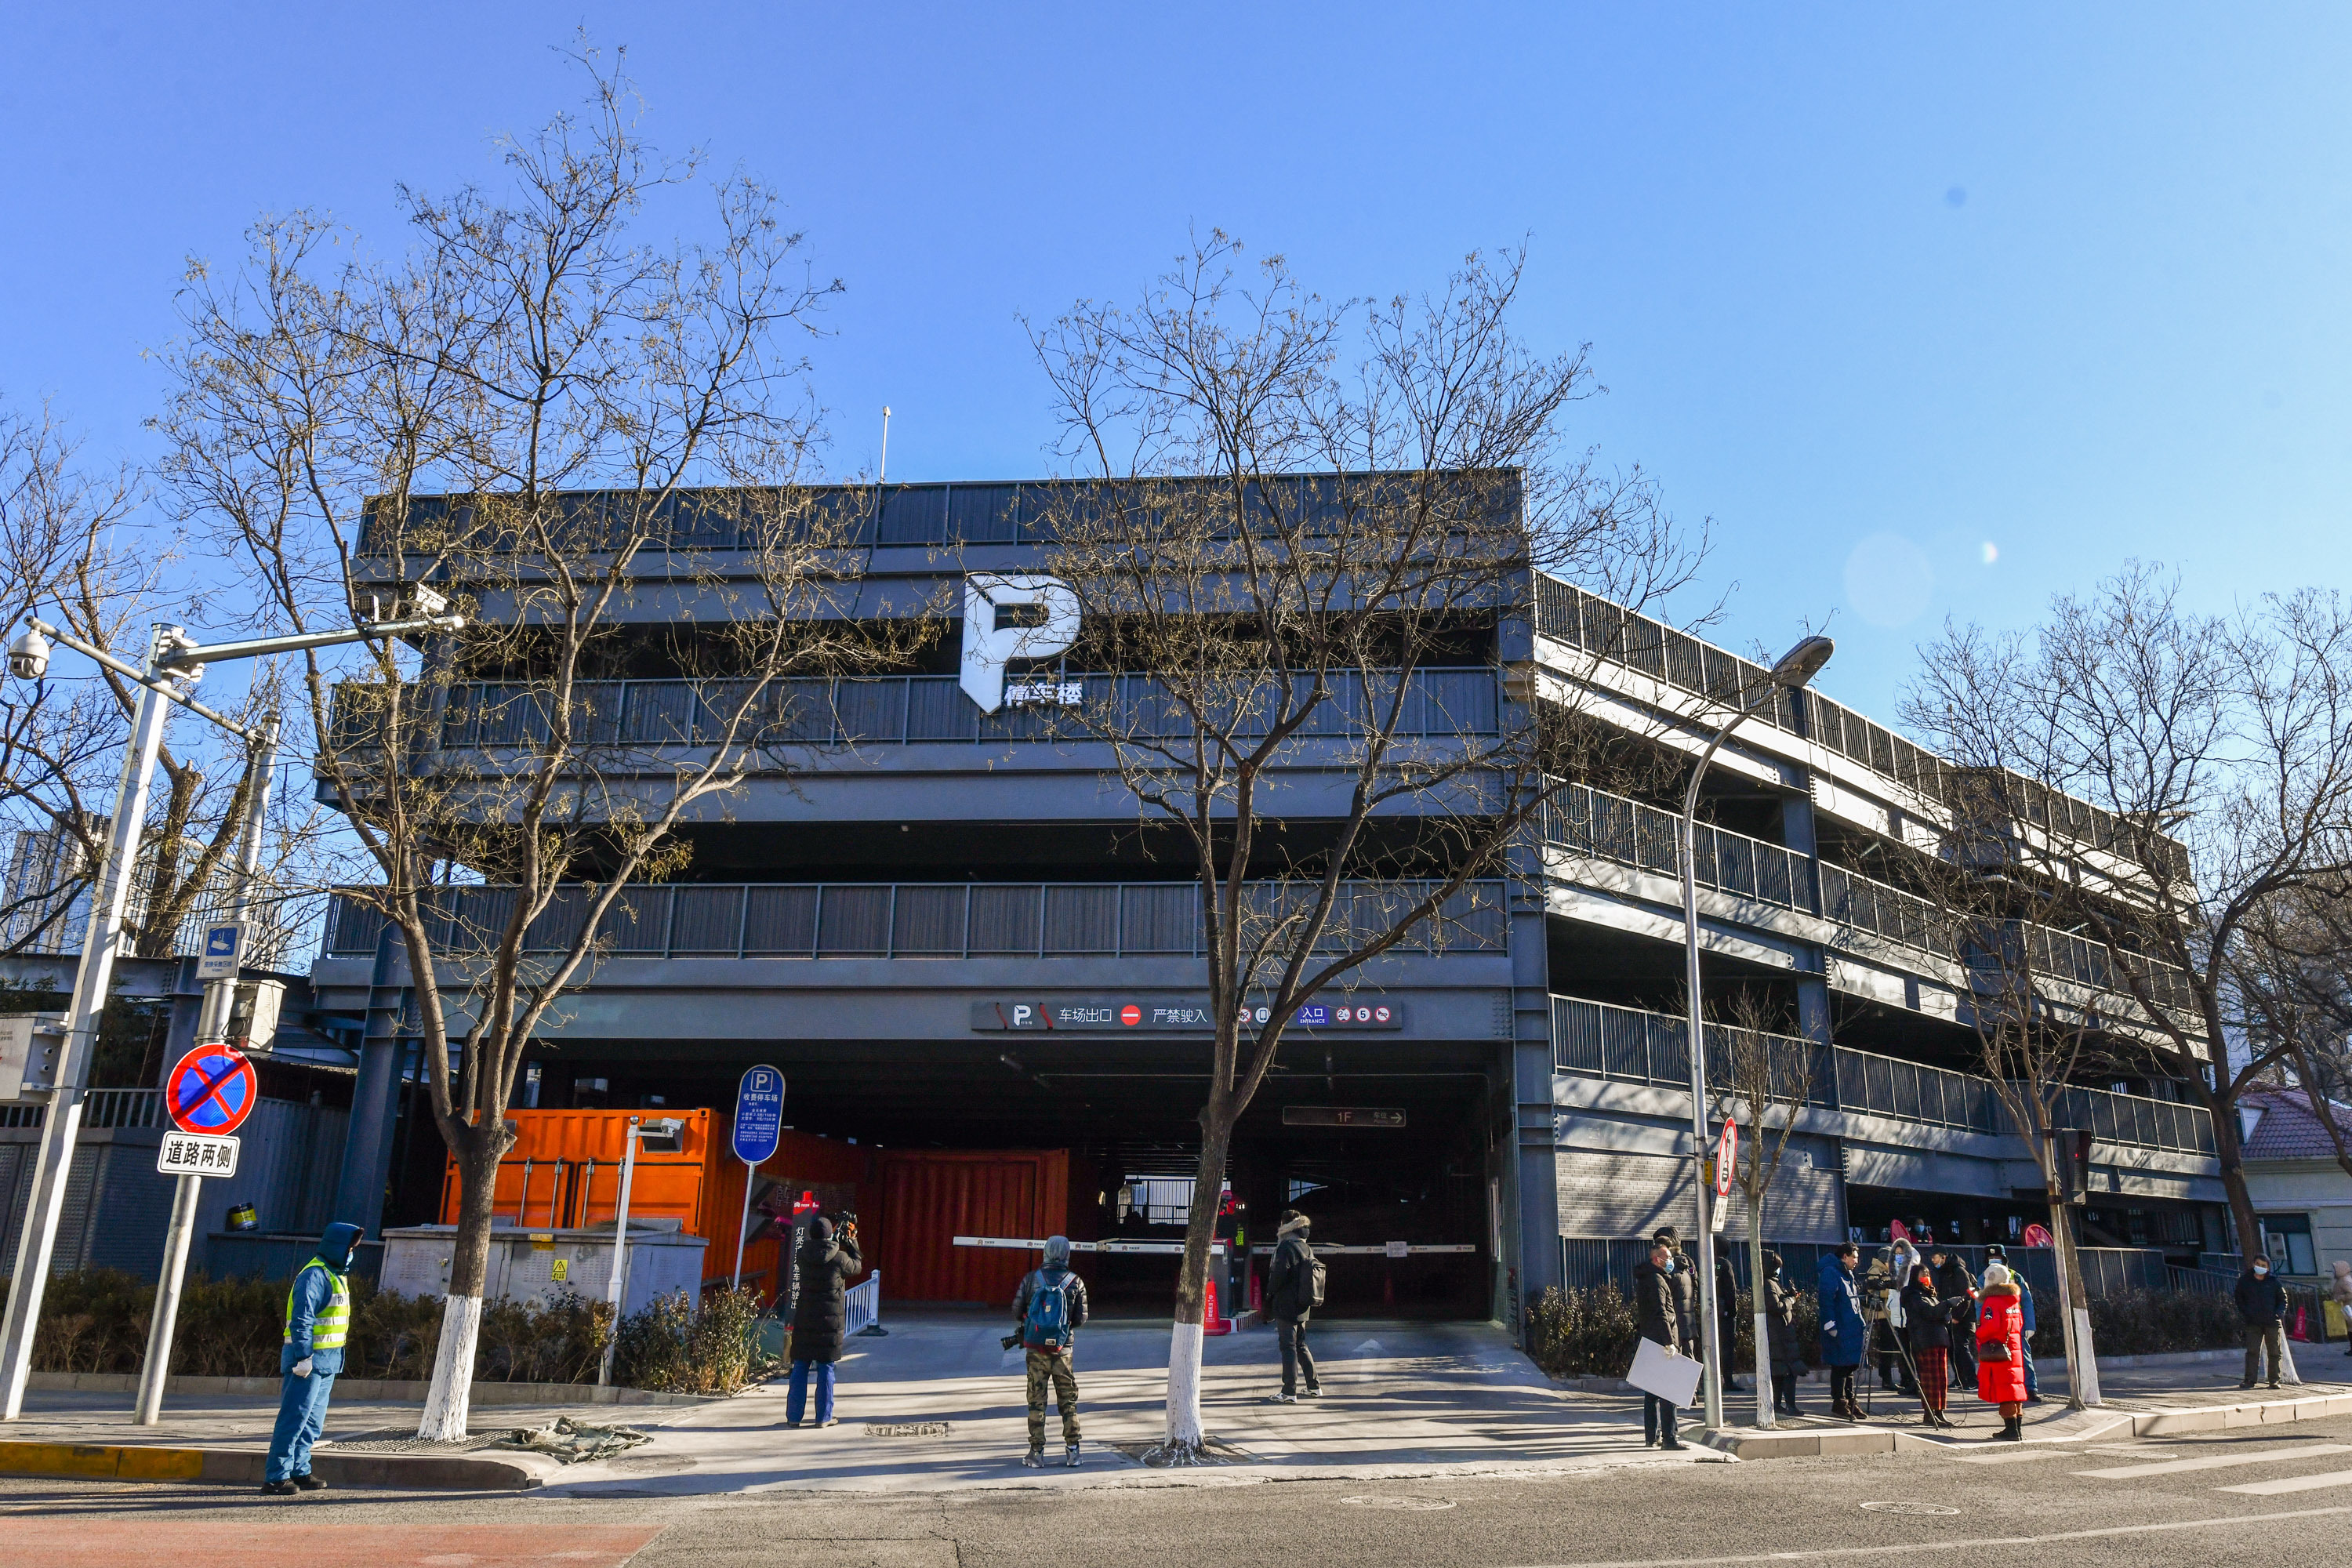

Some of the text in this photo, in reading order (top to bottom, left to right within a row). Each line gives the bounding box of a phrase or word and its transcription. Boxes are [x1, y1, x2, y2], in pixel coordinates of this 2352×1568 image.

[960, 575, 1082, 714] P
[1004, 682, 1083, 706] 停车楼
[1058, 1007, 1207, 1024] 车场出口 严禁驶入
[1302, 1007, 1324, 1018] 入口
[1360, 1010, 1367, 1018] 5
[756, 1073, 768, 1089] P
[742, 1093, 779, 1102] 收费停车场
[1337, 1112, 1352, 1123] 1F
[165, 1140, 233, 1169] 道路两侧
[790, 1226, 805, 1309] 灯亮意车辆驶出
